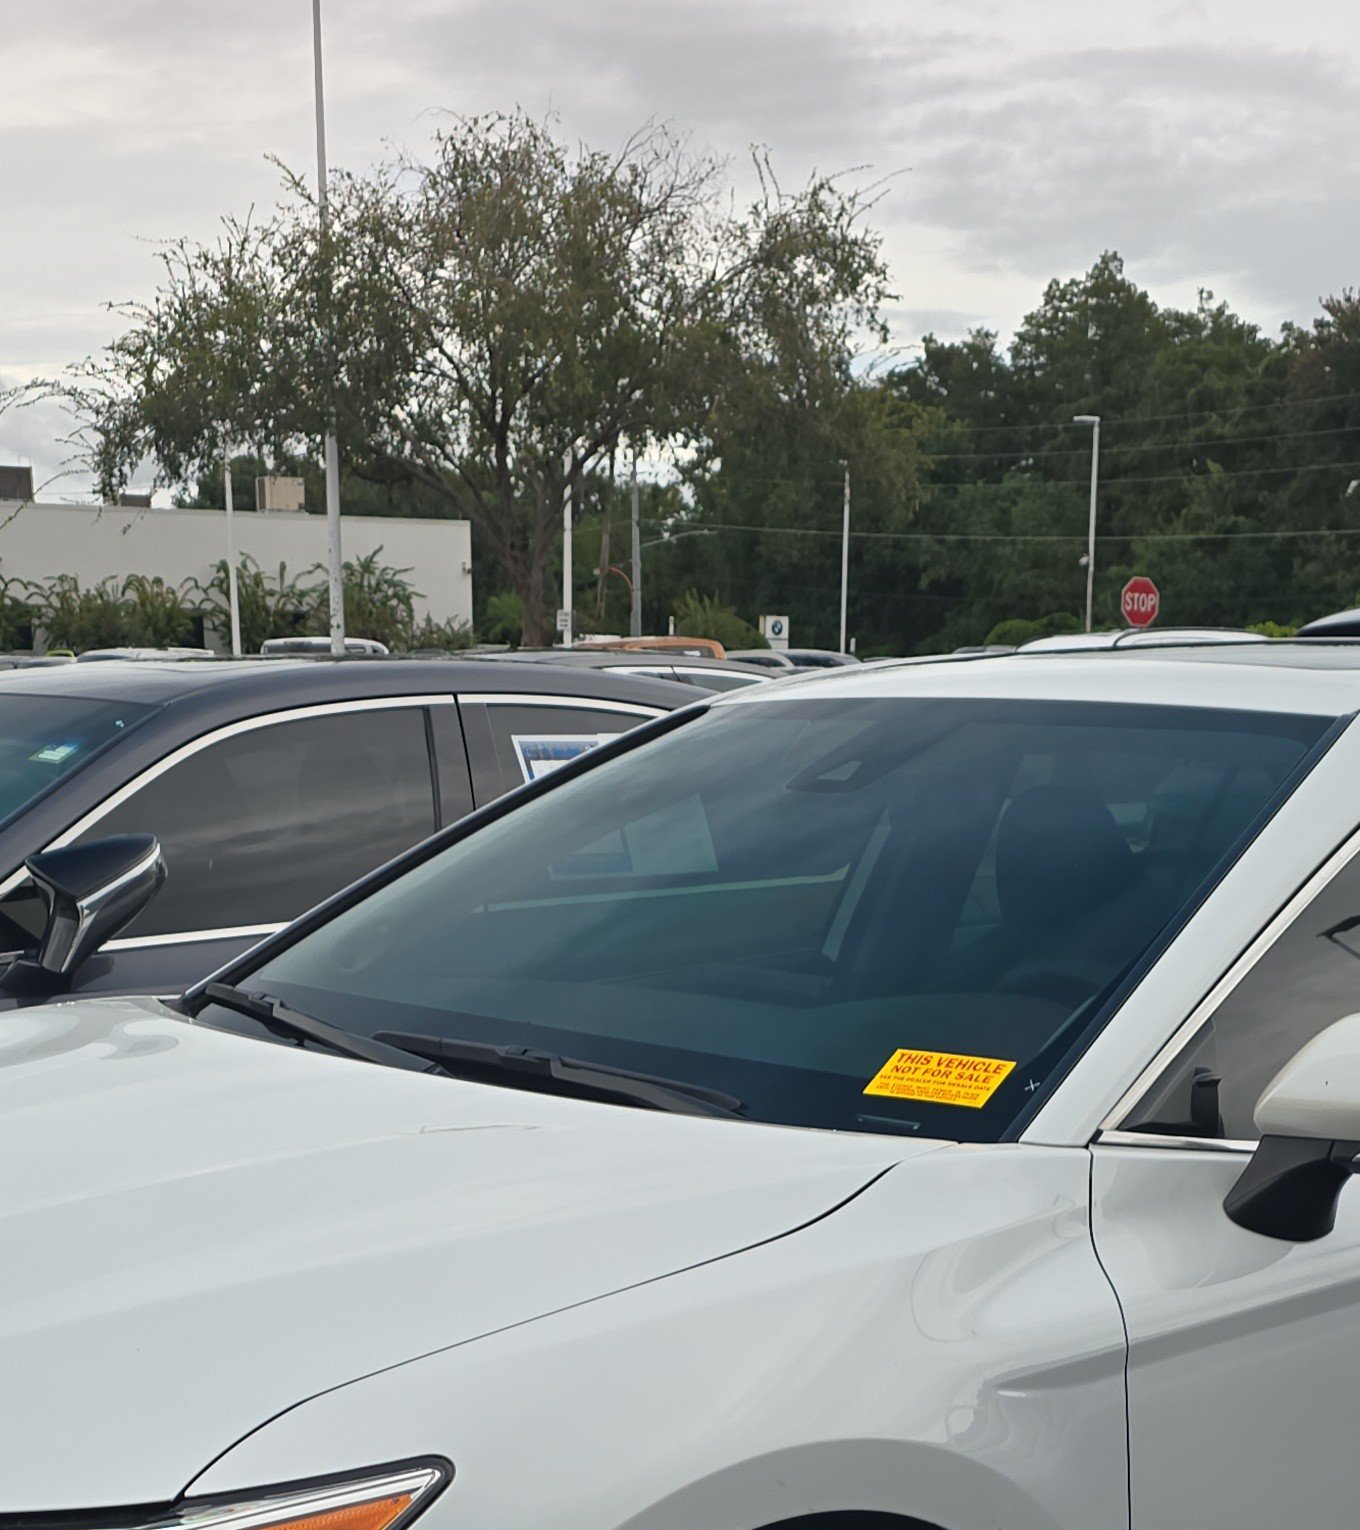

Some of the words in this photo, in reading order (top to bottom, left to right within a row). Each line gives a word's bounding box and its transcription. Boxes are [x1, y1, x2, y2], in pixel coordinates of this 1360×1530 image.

[1125, 591, 1156, 612] STOP
[891, 1065, 921, 1075] NOT
[922, 1068, 952, 1080] FOR
[955, 1072, 994, 1084] SALE
[897, 1053, 933, 1066] THIS
[936, 1057, 1007, 1075] VEHICLE
